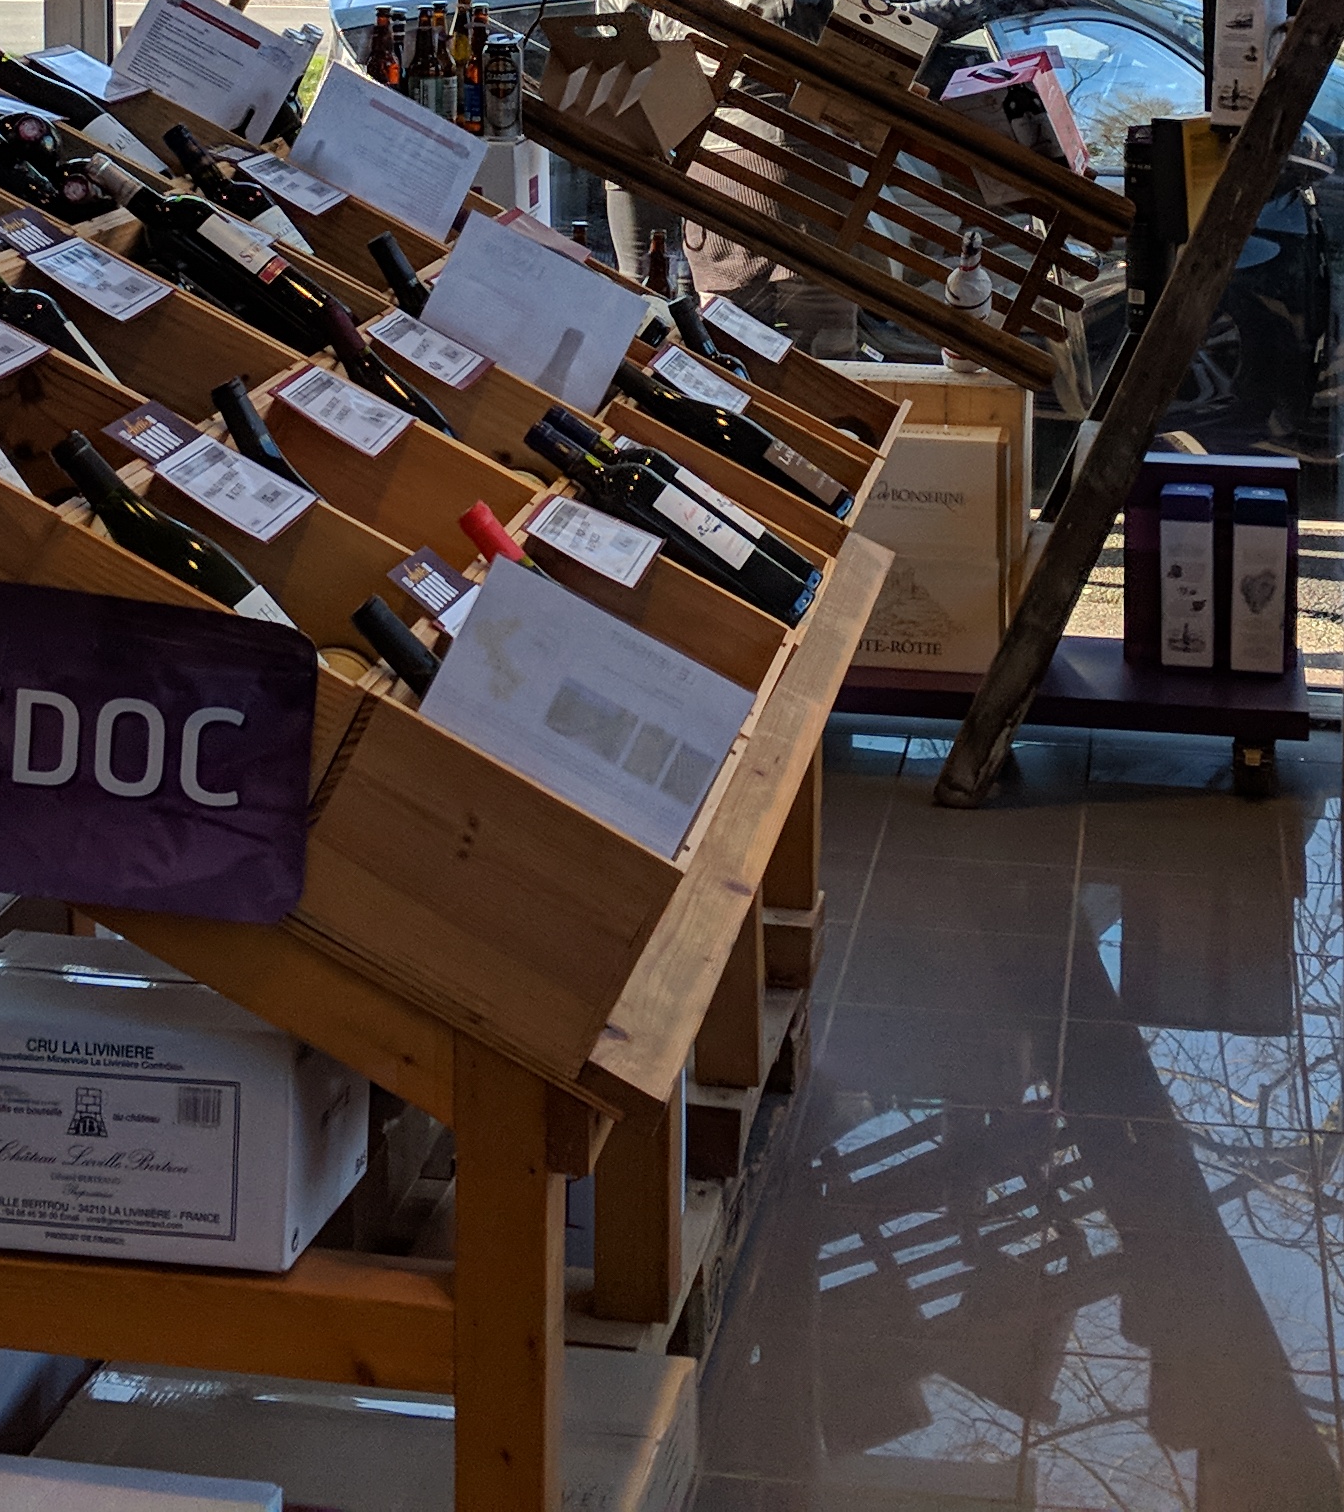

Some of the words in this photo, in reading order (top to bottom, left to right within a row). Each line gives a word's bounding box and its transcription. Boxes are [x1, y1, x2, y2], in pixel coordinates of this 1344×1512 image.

[25, 1038, 58, 1054] CRU
[62, 1040, 81, 1056] LA
[84, 1042, 155, 1061] LIVINIERE
[20, 1198, 69, 1212] BERTROU
[108, 1206, 121, 1217] LA
[179, 1210, 220, 1224] FRANCE
